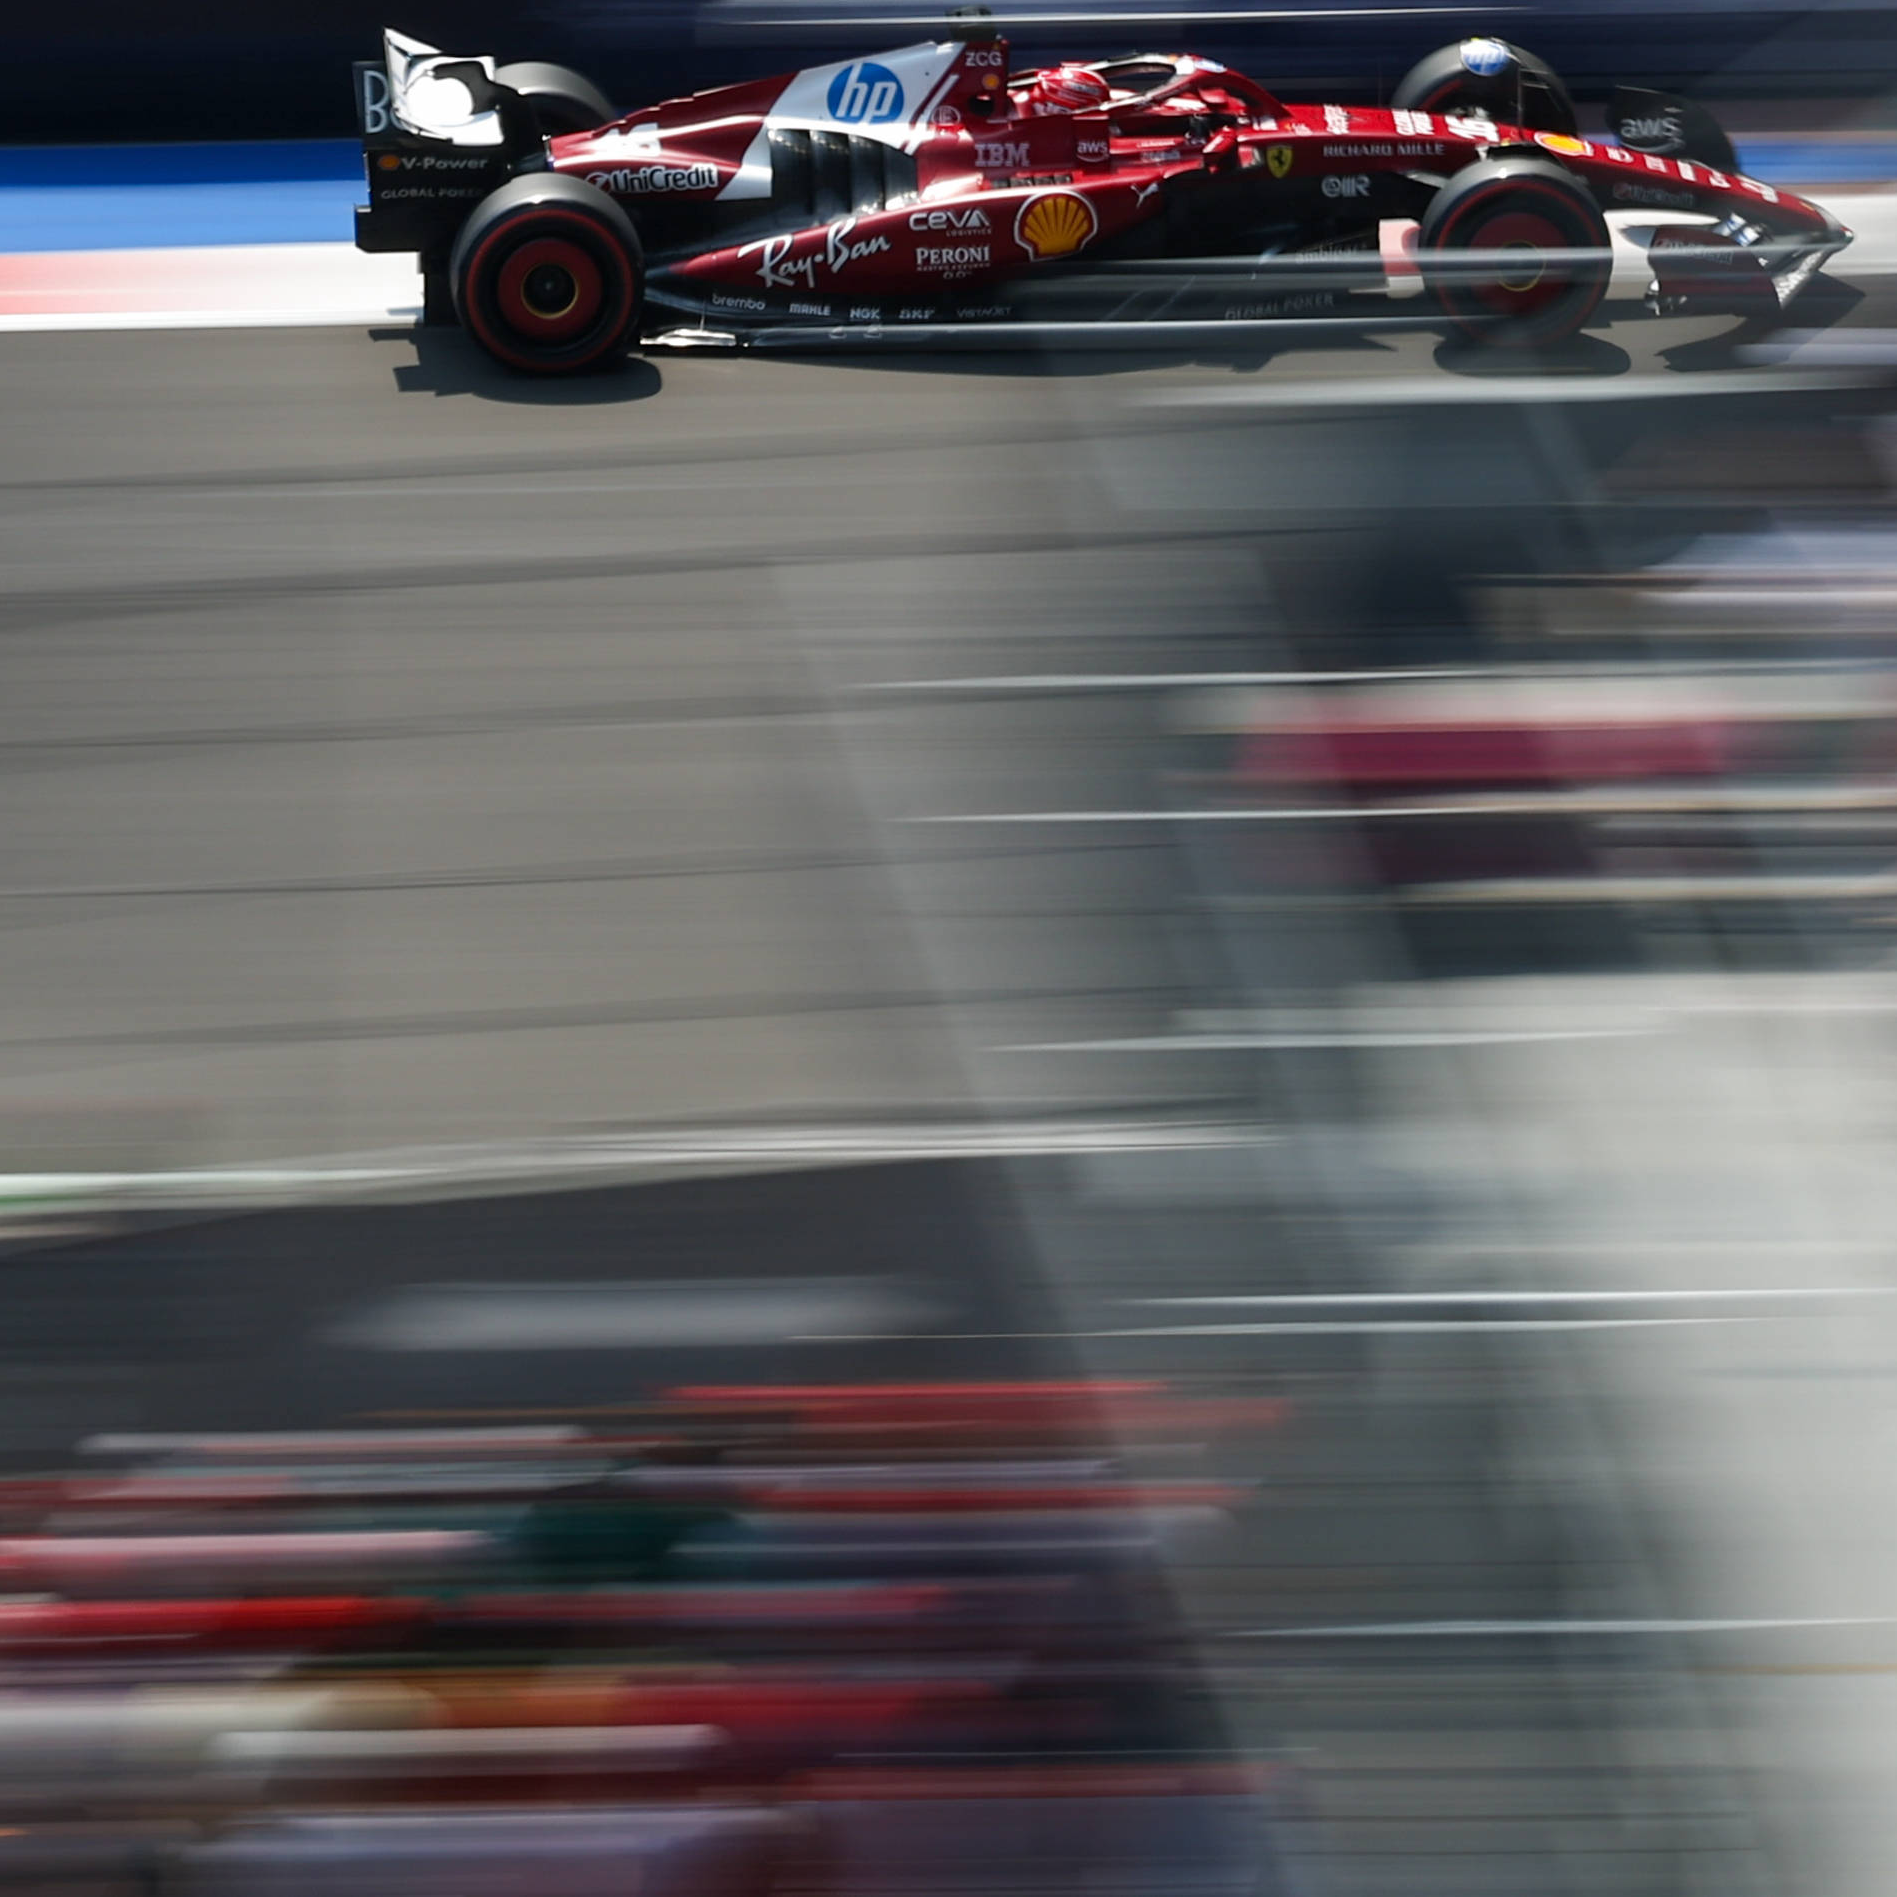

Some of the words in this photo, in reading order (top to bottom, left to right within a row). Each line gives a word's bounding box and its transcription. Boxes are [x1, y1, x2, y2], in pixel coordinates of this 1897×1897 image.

[966, 52, 1002, 67] ZCG
[835, 64, 897, 124] hp
[1077, 140, 1109, 154] aws
[1324, 144, 1393, 157] RICHARD
[1398, 143, 1446, 155] MILLE
[975, 143, 1029, 167] IBM
[402, 156, 488, 170] V-Power
[612, 165, 719, 193] UniCredit
[381, 187, 435, 200] GLOBAL
[915, 246, 991, 265] PERONI
[712, 294, 766, 311] brembo
[789, 303, 832, 316] MAHLE
